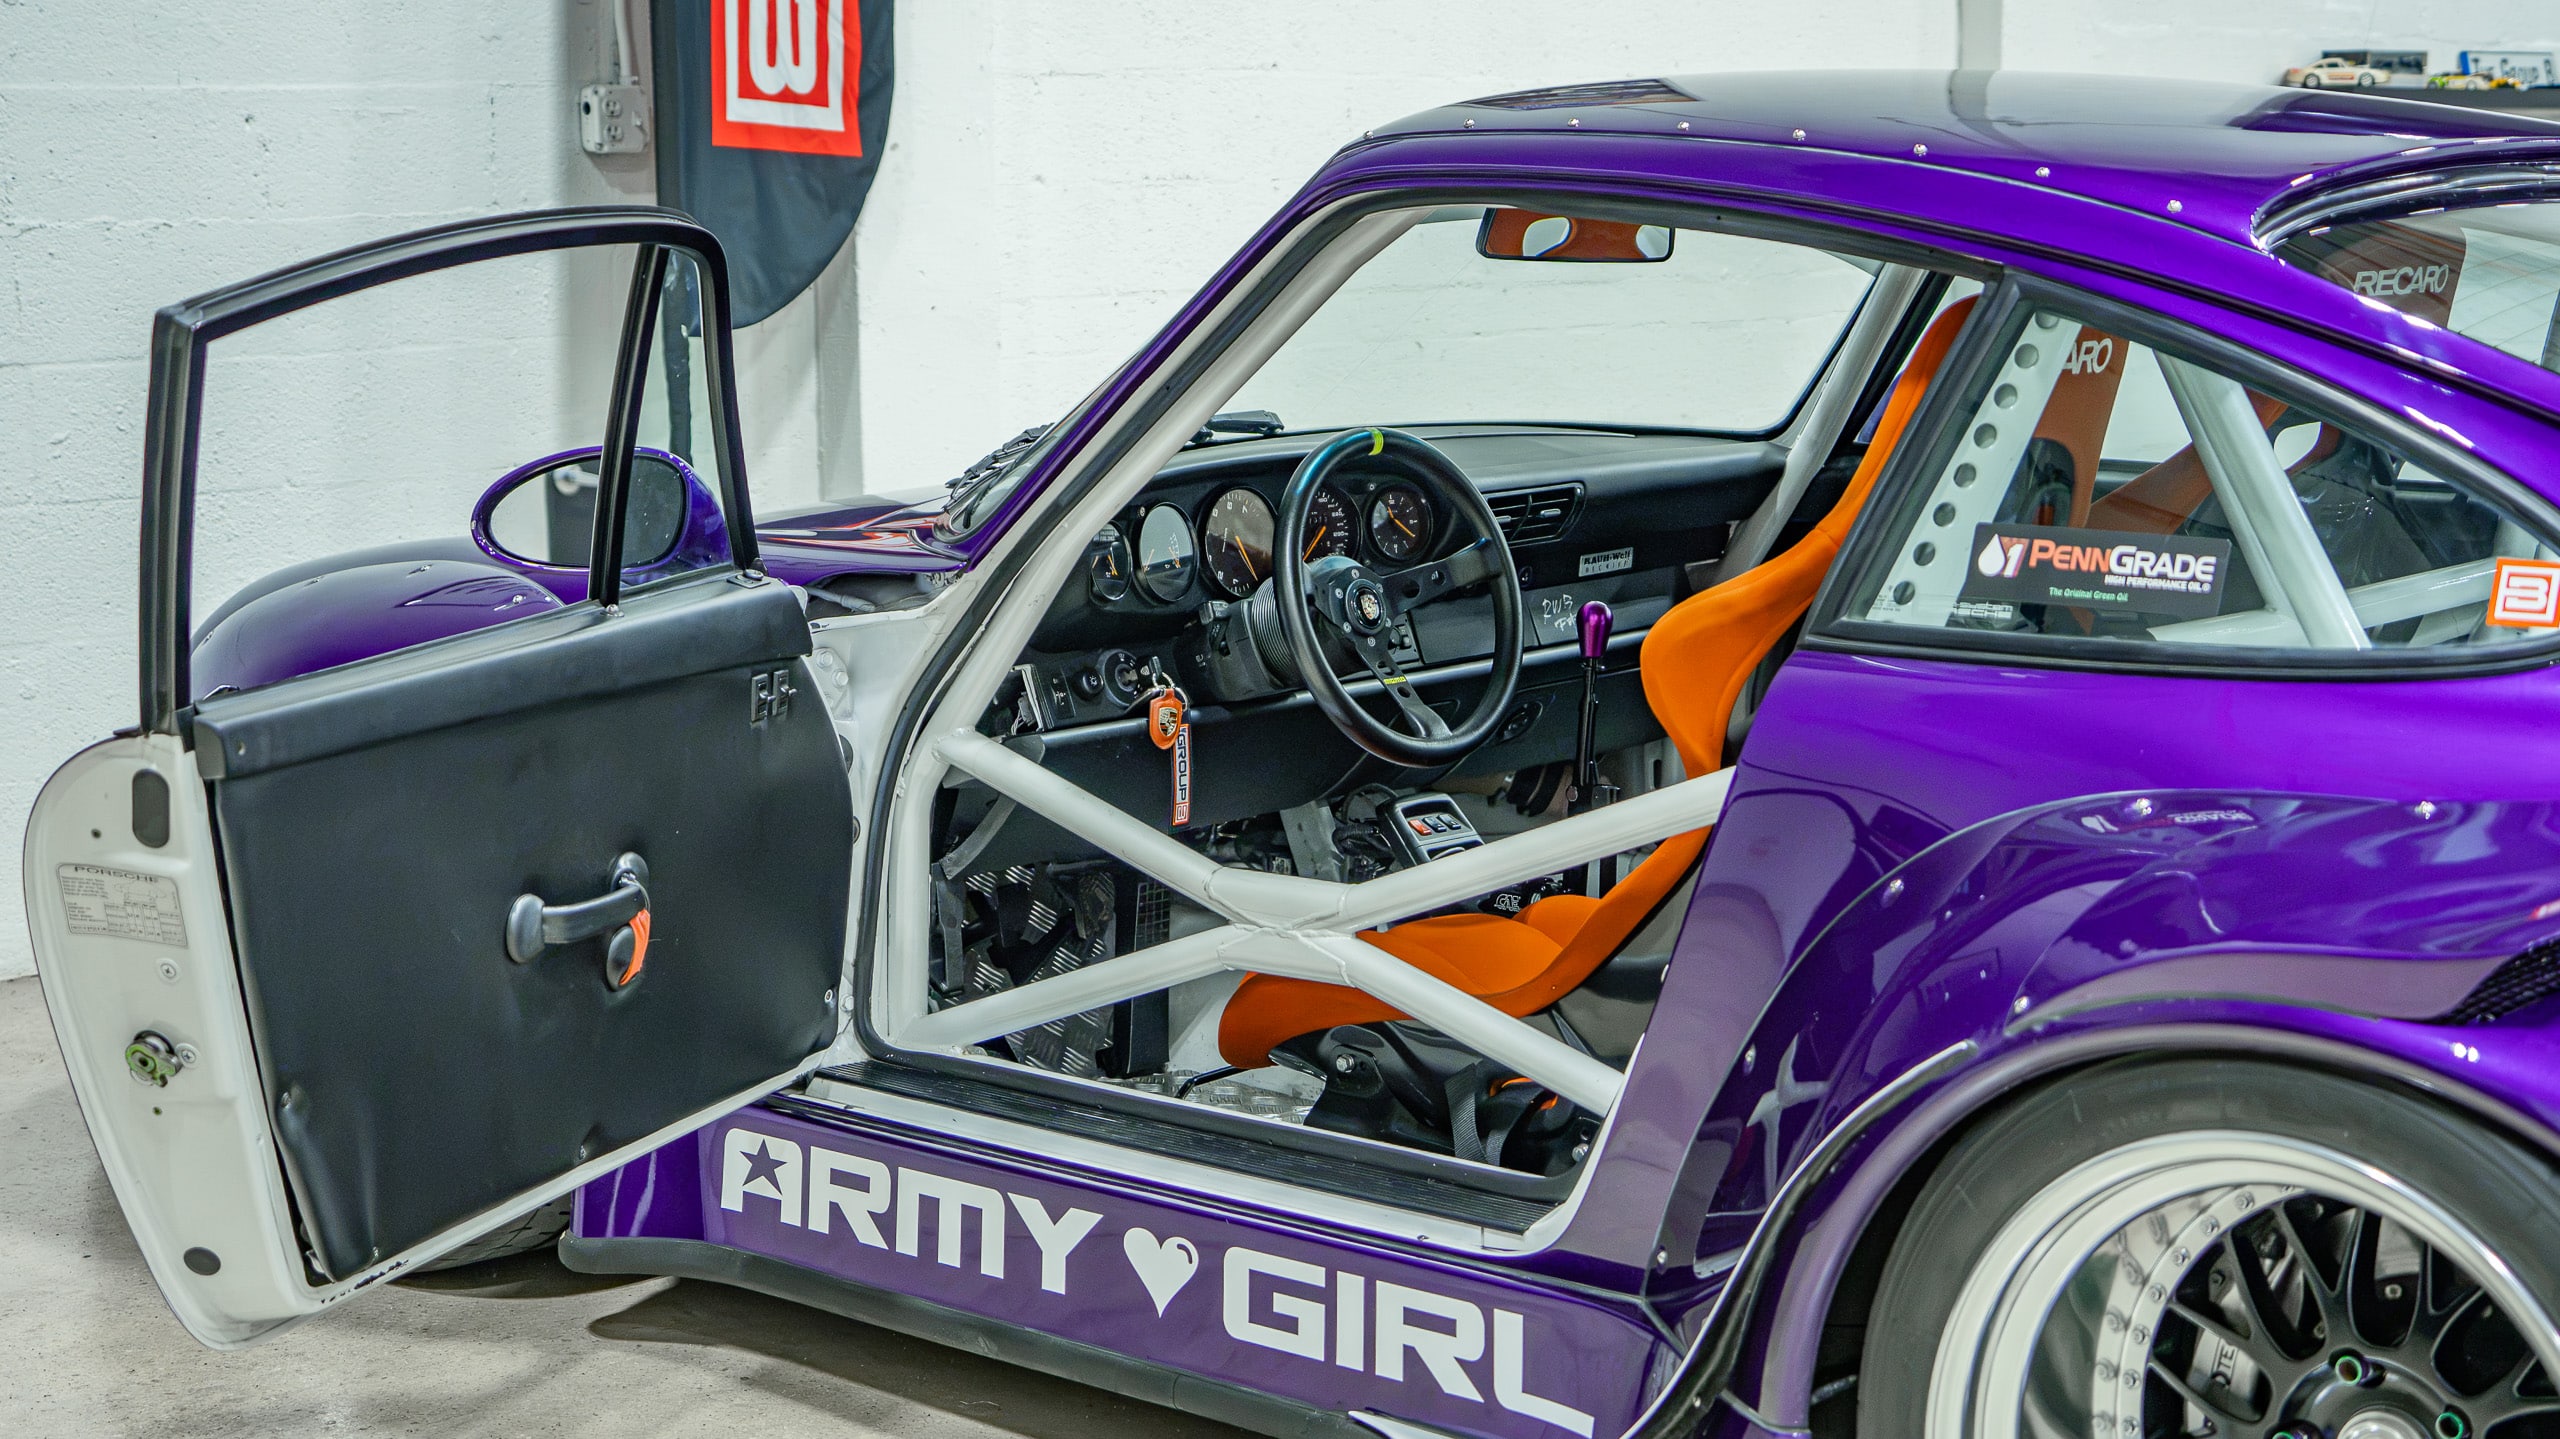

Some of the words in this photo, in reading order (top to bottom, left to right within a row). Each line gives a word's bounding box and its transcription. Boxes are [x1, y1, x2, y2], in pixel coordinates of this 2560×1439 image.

[2354, 264, 2449, 296] RECARO
[2062, 338, 2113, 375] ARO
[2049, 587, 2062, 597] The
[2064, 588, 2092, 599] Original
[2093, 590, 2115, 601] Green
[2117, 592, 2129, 602] Oil
[2104, 574, 2126, 587] HIGH
[2126, 577, 2188, 592] PERFORMANCE
[74, 866, 158, 882] PORSCHE
[721, 1128, 1103, 1295] ARMY
[1222, 1245, 1595, 1439] GIRL
